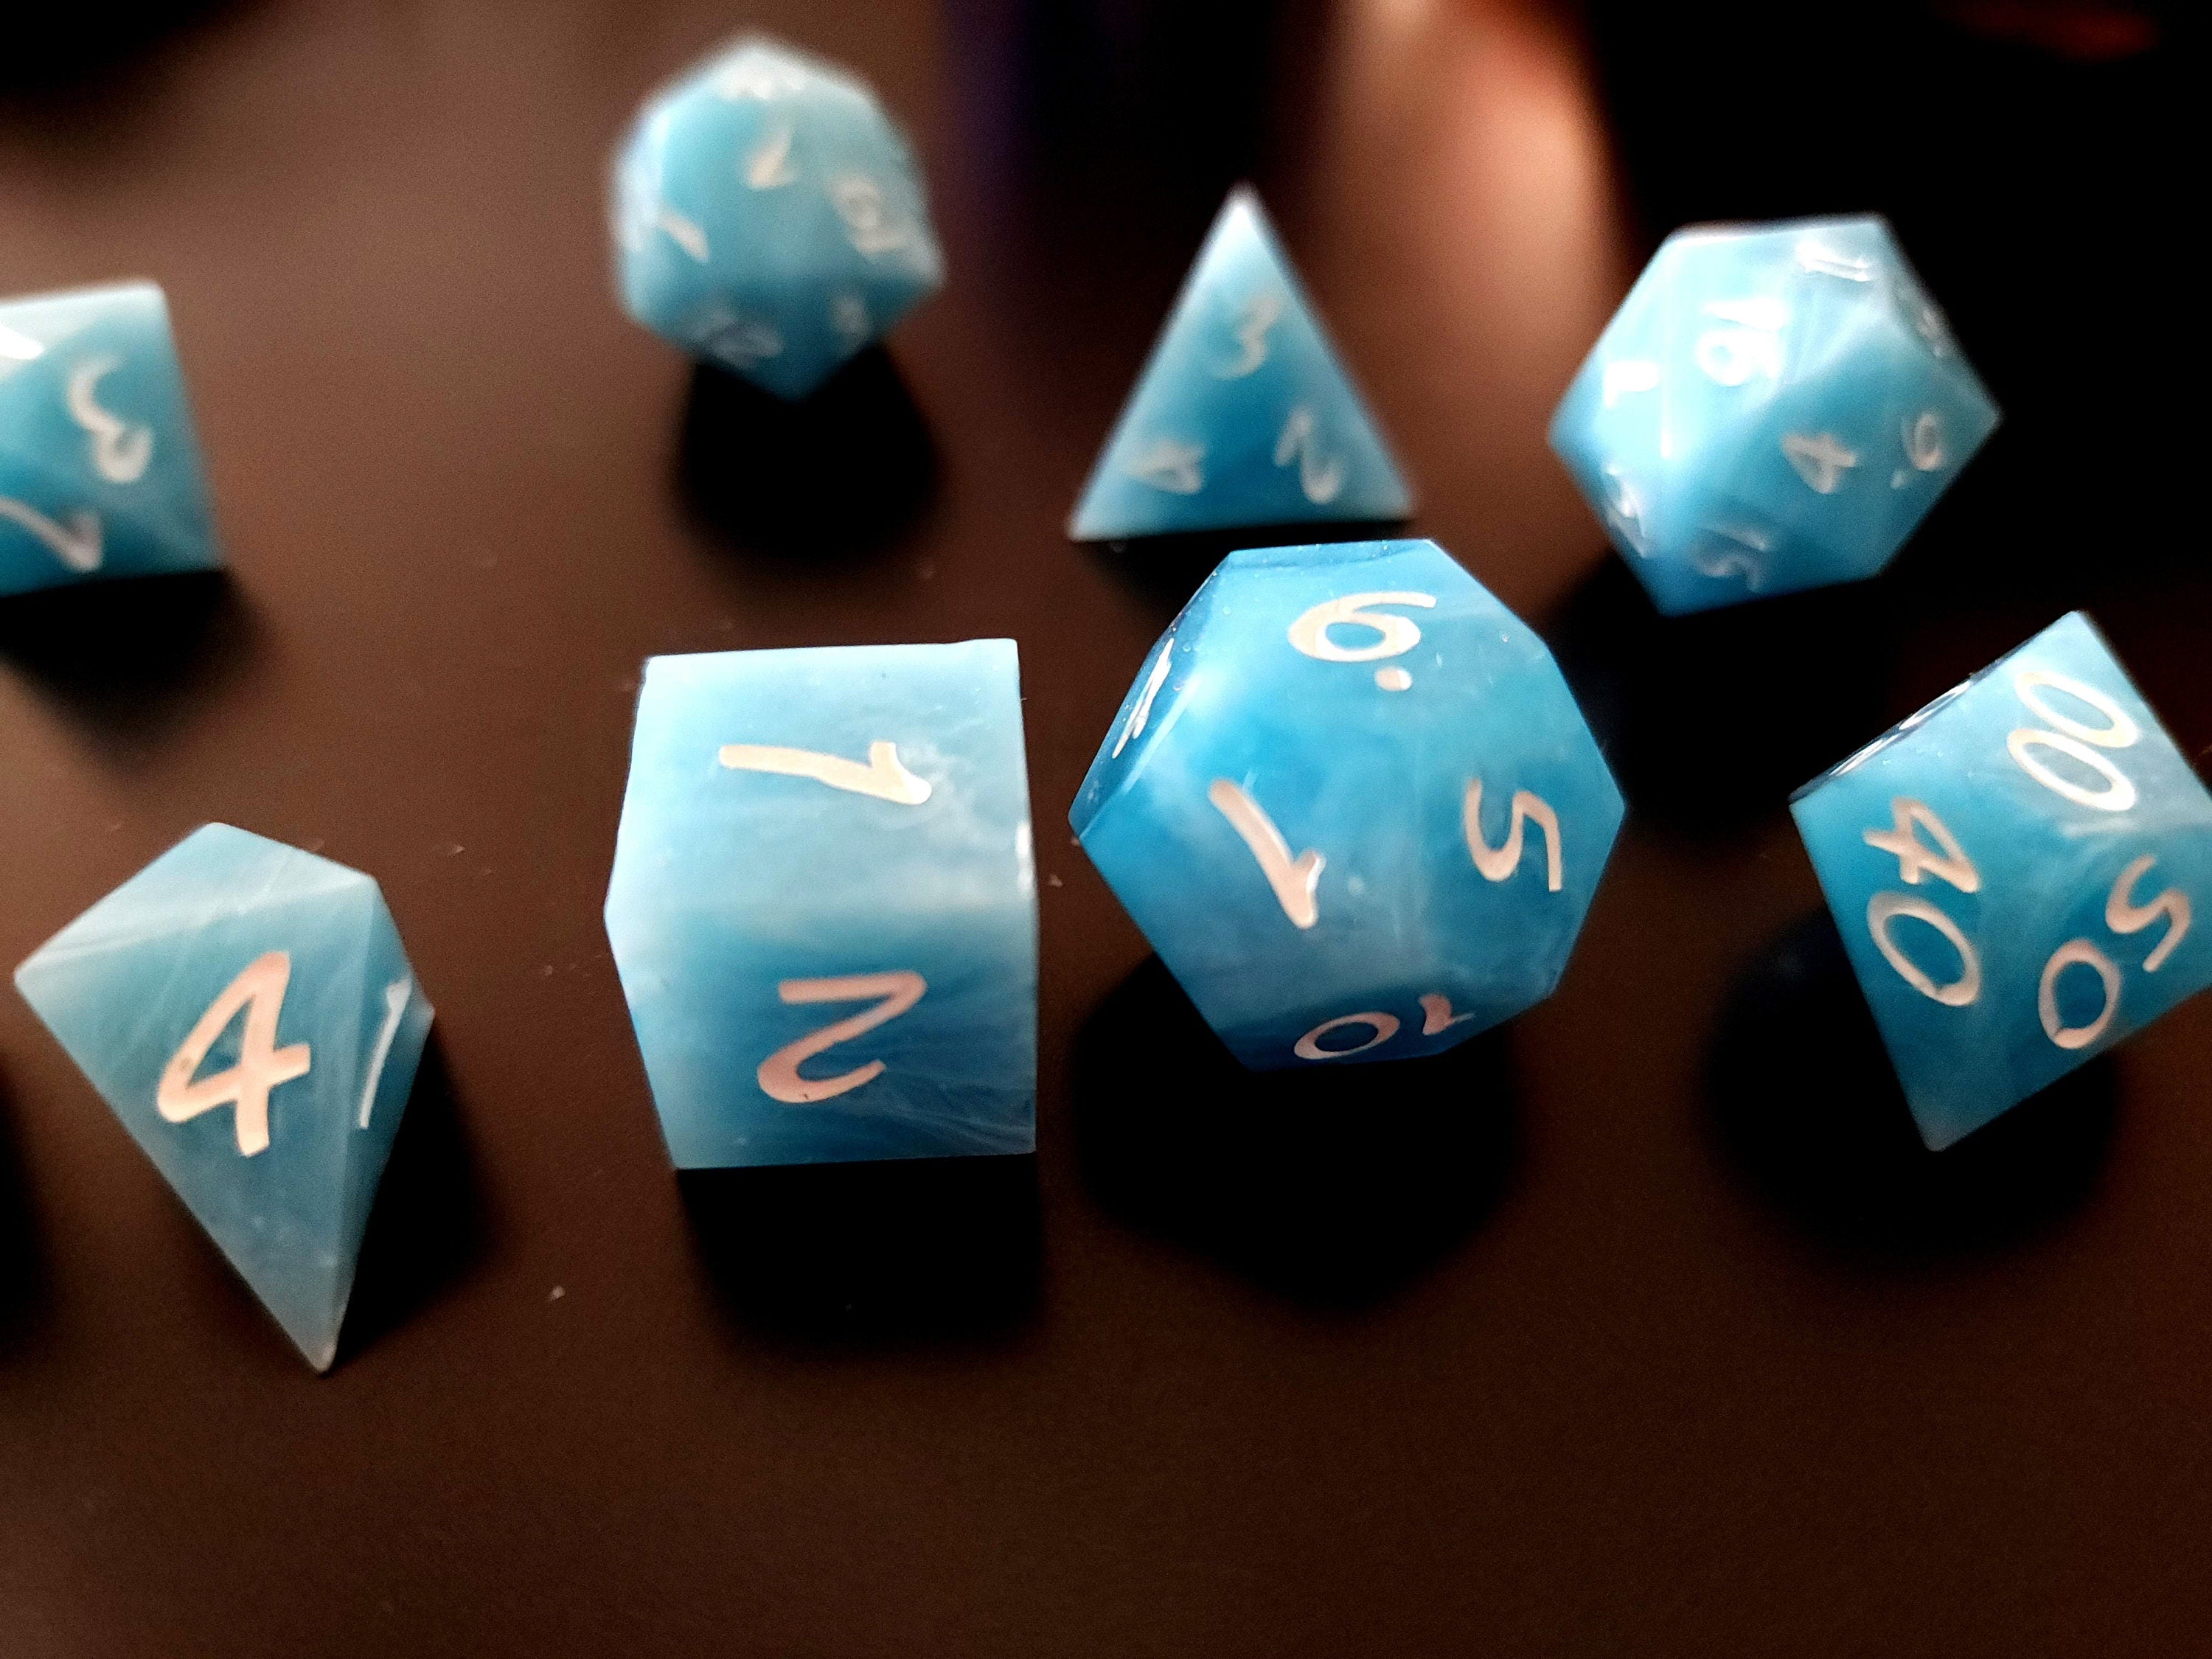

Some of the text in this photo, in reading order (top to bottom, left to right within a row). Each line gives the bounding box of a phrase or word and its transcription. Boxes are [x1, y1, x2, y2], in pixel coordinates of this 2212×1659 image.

[1213, 293, 1284, 380] 3
[66, 354, 155, 484] 3
[1778, 432, 1857, 495] 4
[719, 742, 933, 806] 1
[2007, 671, 2140, 811] 00
[1207, 778, 1326, 930] 1
[1464, 776, 1562, 892] 5
[1863, 796, 1980, 1007] 40
[2038, 855, 2191, 1050] 50
[156, 951, 310, 1158] 4
[757, 971, 928, 1104] 2
[1294, 991, 1475, 1060] 10
